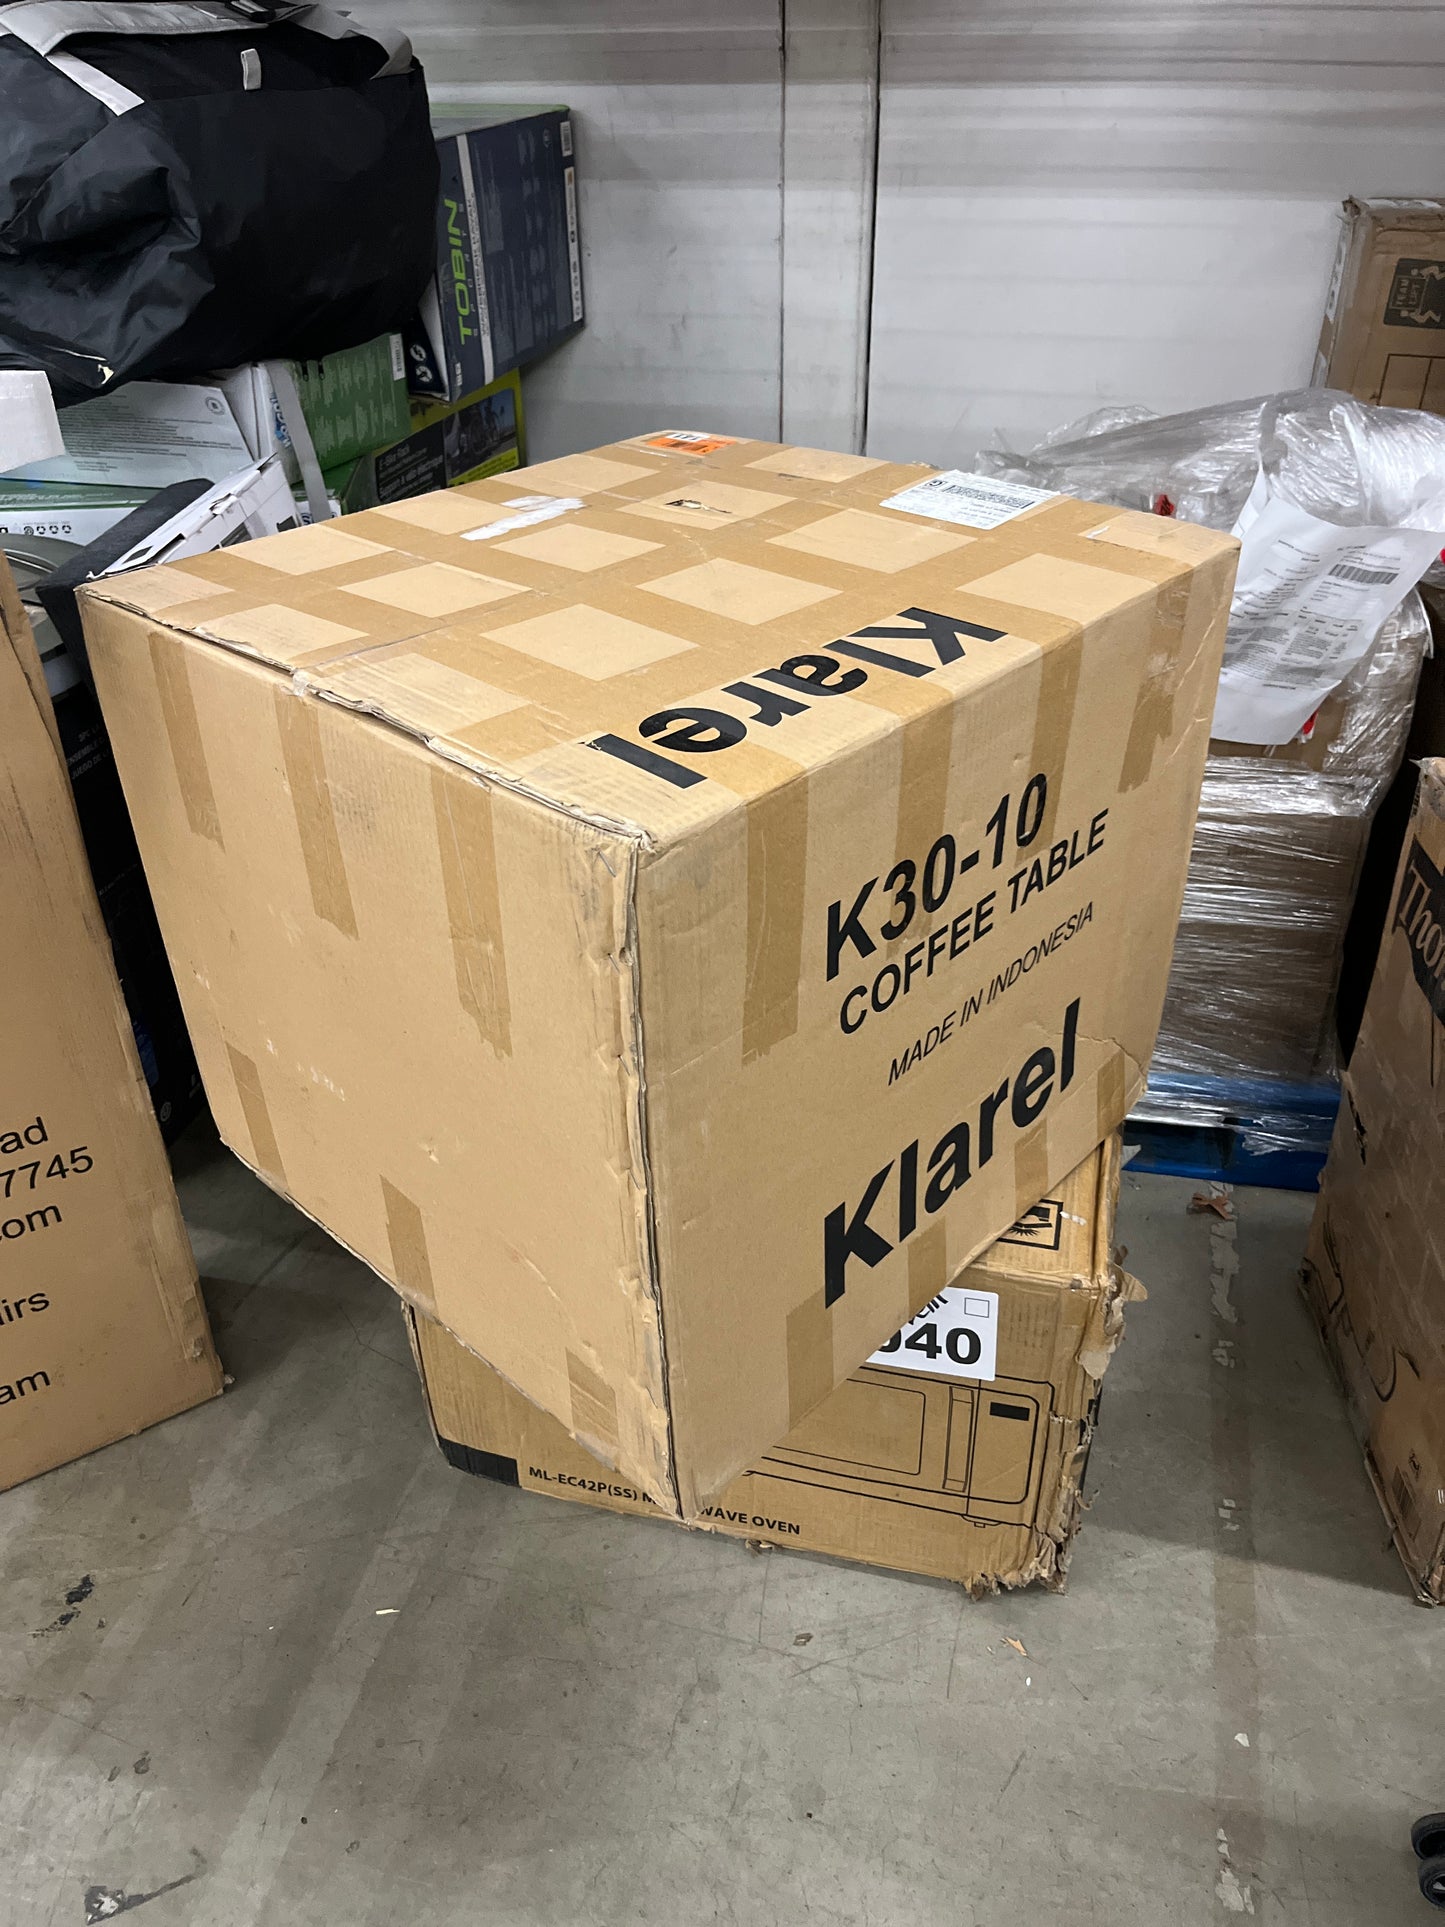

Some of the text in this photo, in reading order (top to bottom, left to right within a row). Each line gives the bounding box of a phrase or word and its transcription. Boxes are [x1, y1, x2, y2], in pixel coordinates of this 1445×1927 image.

[444, 199, 472, 345] TOBIN
[584, 607, 1008, 789] Klarel
[826, 773, 1047, 982] K30-10
[840, 808, 1108, 1034] COFFEE TABLE
[888, 901, 1093, 1086] MADE IN INDONESIA
[0, 1146, 93, 1198] 7745
[0, 1206, 62, 1241] om
[825, 997, 1080, 1309] Klarel
[0, 1293, 49, 1325] irs
[529, 1467, 637, 1501] ML-EC42P(SS)
[752, 1516, 800, 1535] OVEN
